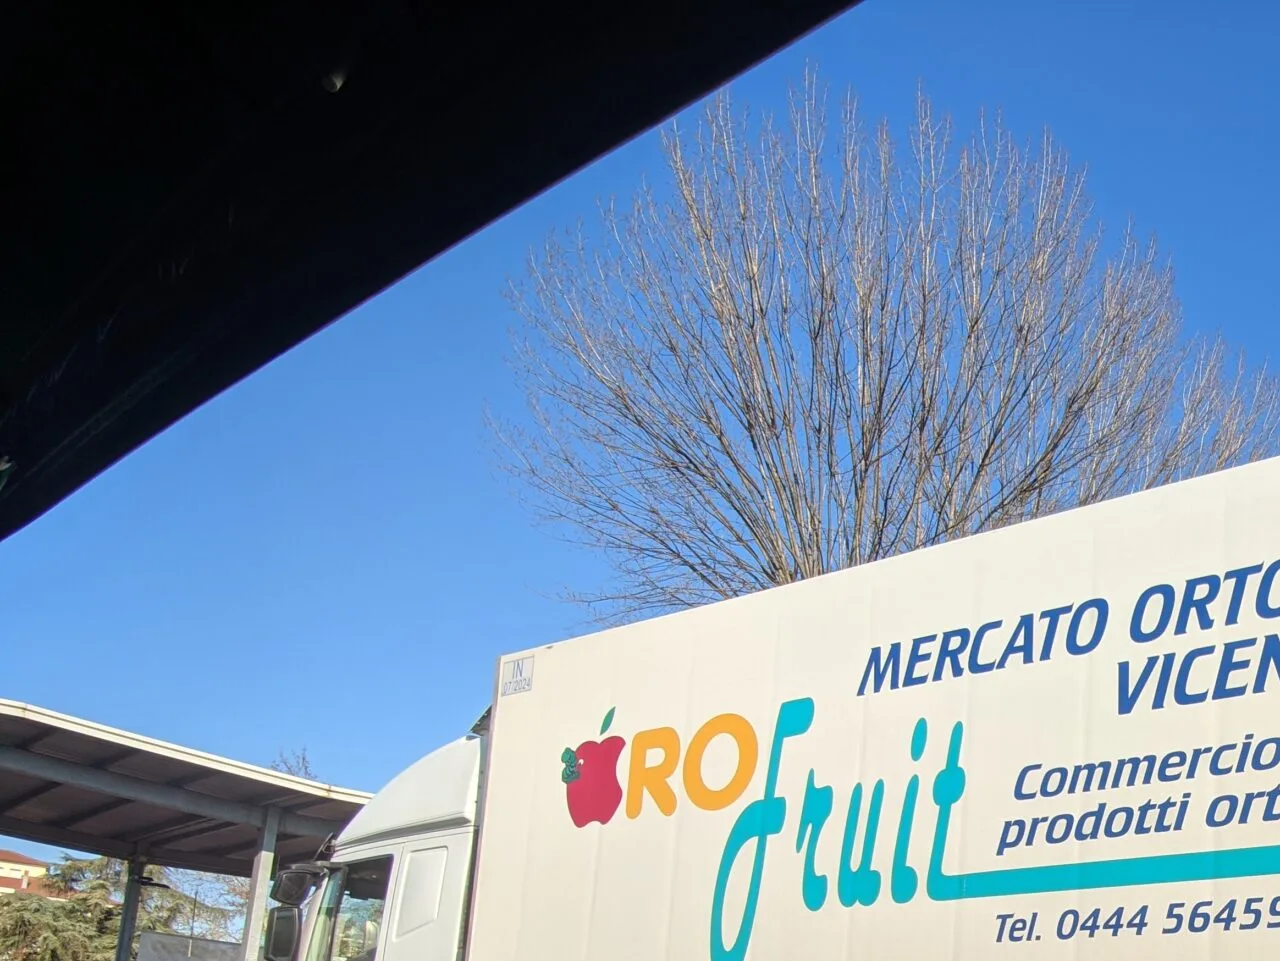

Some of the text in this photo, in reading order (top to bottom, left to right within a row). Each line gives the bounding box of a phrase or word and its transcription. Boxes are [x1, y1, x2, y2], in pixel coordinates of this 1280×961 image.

[512, 659, 524, 679] IN
[856, 598, 1110, 697] MERCATO
[995, 792, 1192, 856] prodotti
[995, 912, 1042, 943] Tel.
[1056, 904, 1148, 940] 0444
